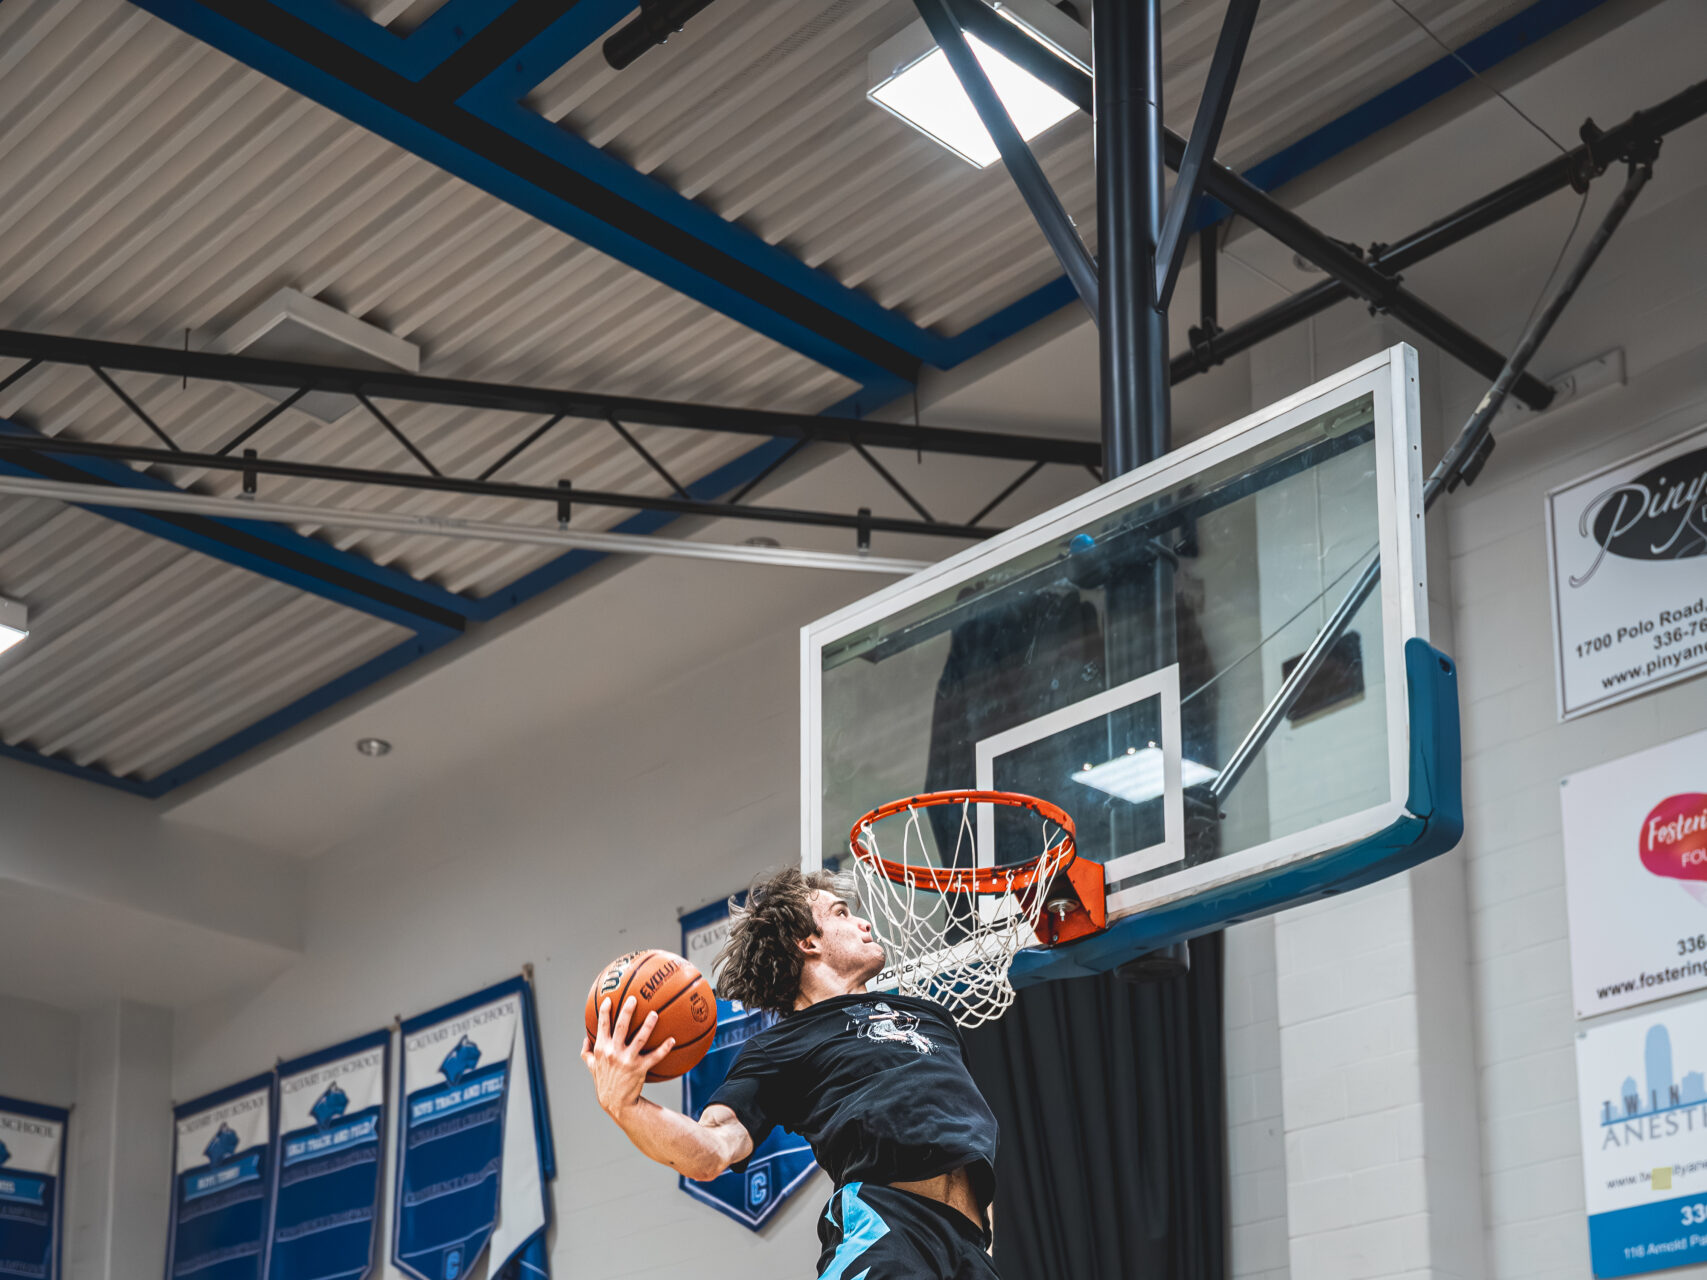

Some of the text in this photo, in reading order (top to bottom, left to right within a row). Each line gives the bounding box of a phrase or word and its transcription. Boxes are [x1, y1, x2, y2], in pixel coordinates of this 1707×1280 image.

[1569, 471, 1707, 588] Piny
[1576, 633, 1612, 658] 1700
[1617, 620, 1654, 643] Polo
[473, 1001, 515, 1026] SCHOOL
[435, 1090, 462, 1111] TRACK
[463, 1083, 480, 1101] AND
[1602, 1083, 1680, 1124] TWIN
[1681, 1204, 1707, 1227] 33
[1647, 1238, 1688, 1255] Arnold
